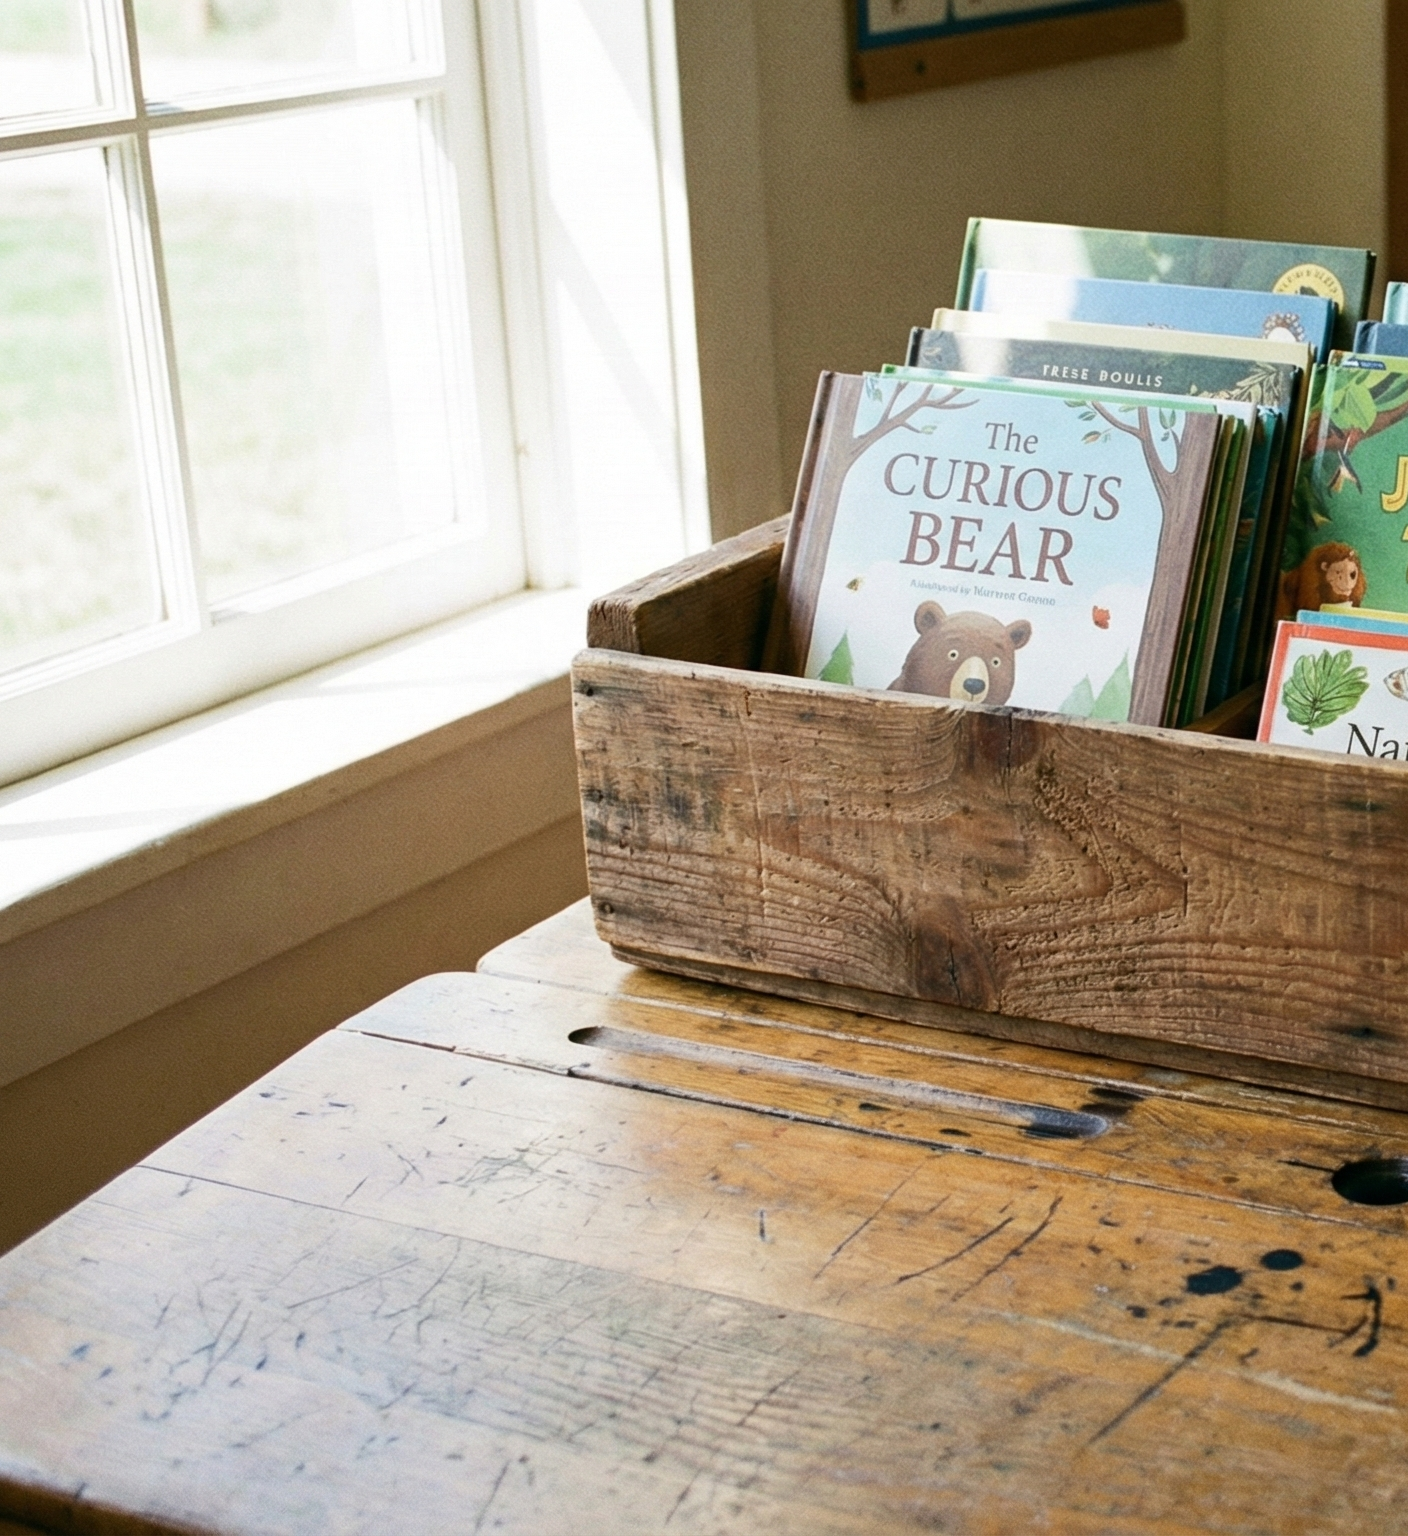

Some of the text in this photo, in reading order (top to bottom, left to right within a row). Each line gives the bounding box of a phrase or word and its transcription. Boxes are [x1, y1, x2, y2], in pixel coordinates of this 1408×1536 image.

[985, 421, 1039, 455] The
[883, 453, 1122, 521] CURIOUS
[900, 510, 1074, 586] BEAR
